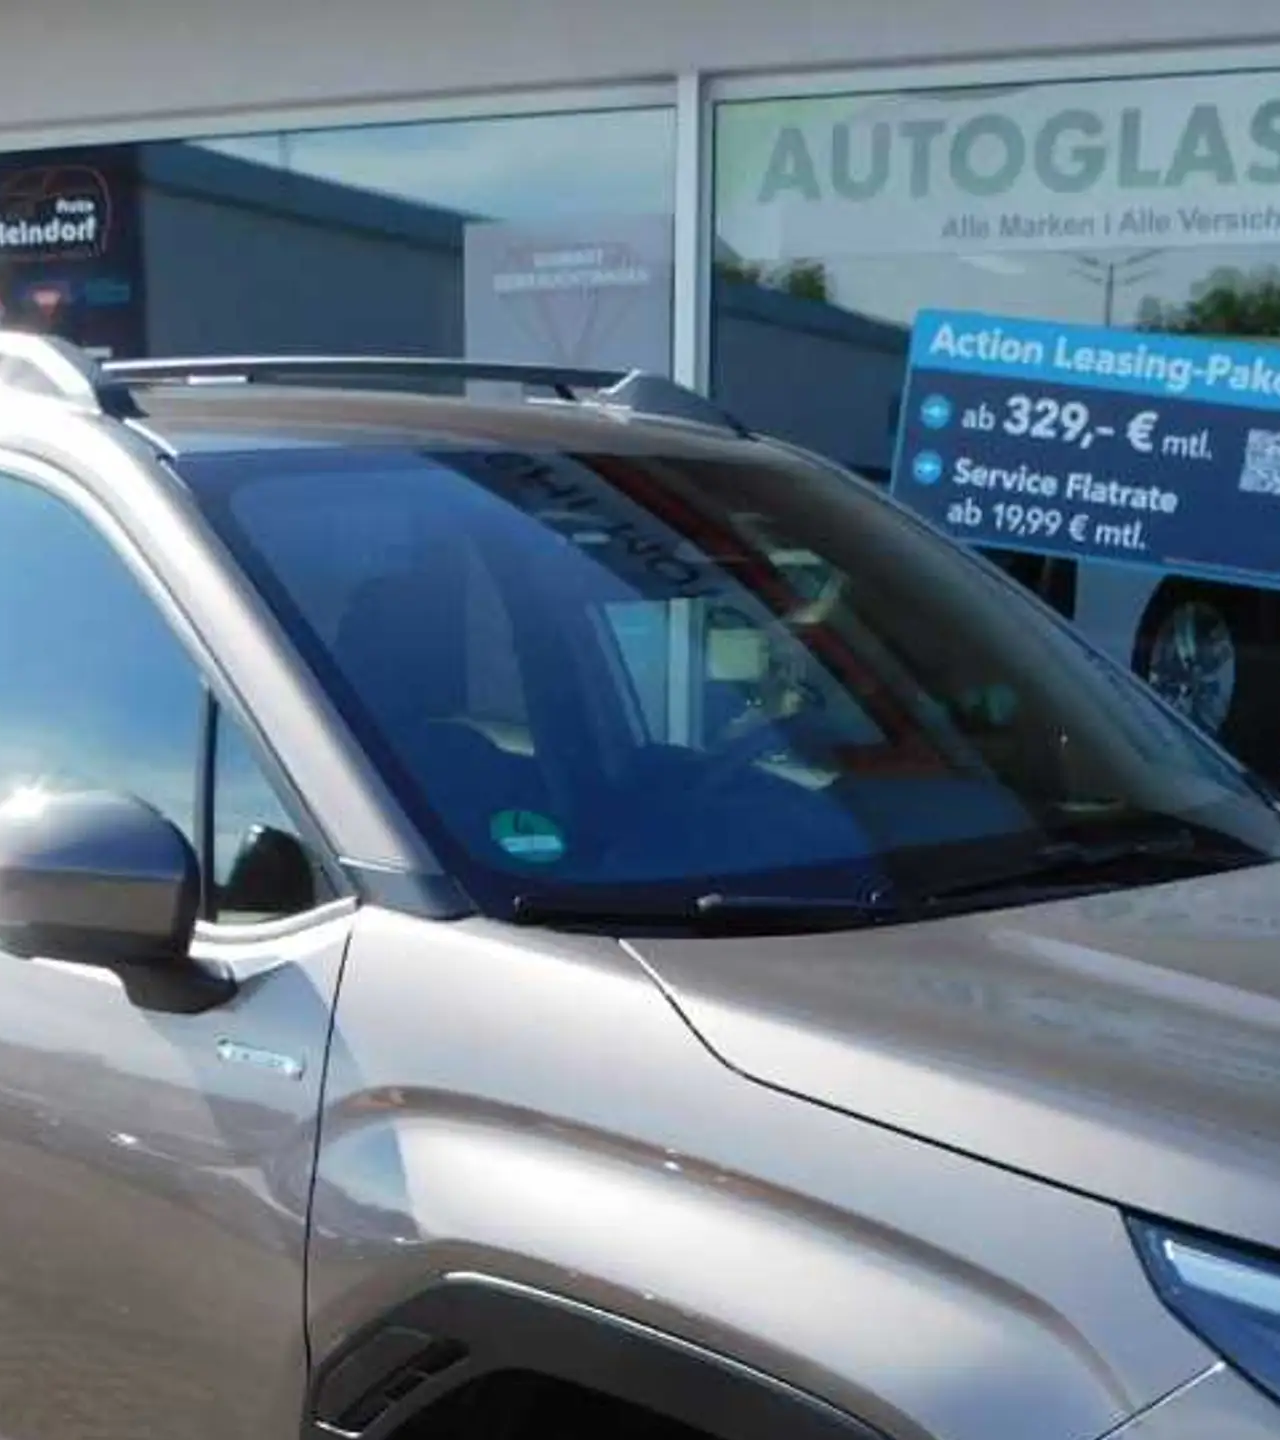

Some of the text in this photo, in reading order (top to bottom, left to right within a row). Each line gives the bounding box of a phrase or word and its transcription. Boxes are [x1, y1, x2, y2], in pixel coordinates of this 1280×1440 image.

[942, 214, 989, 238] Alle
[999, 210, 1095, 238] Marken
[1120, 208, 1169, 234] Alle
[929, 322, 1044, 368] Action
[962, 393, 1213, 461] ab 329,- € mtl.
[952, 457, 1179, 514] Service Flatrate
[946, 497, 1147, 551] ab 19,99 € mtl.
